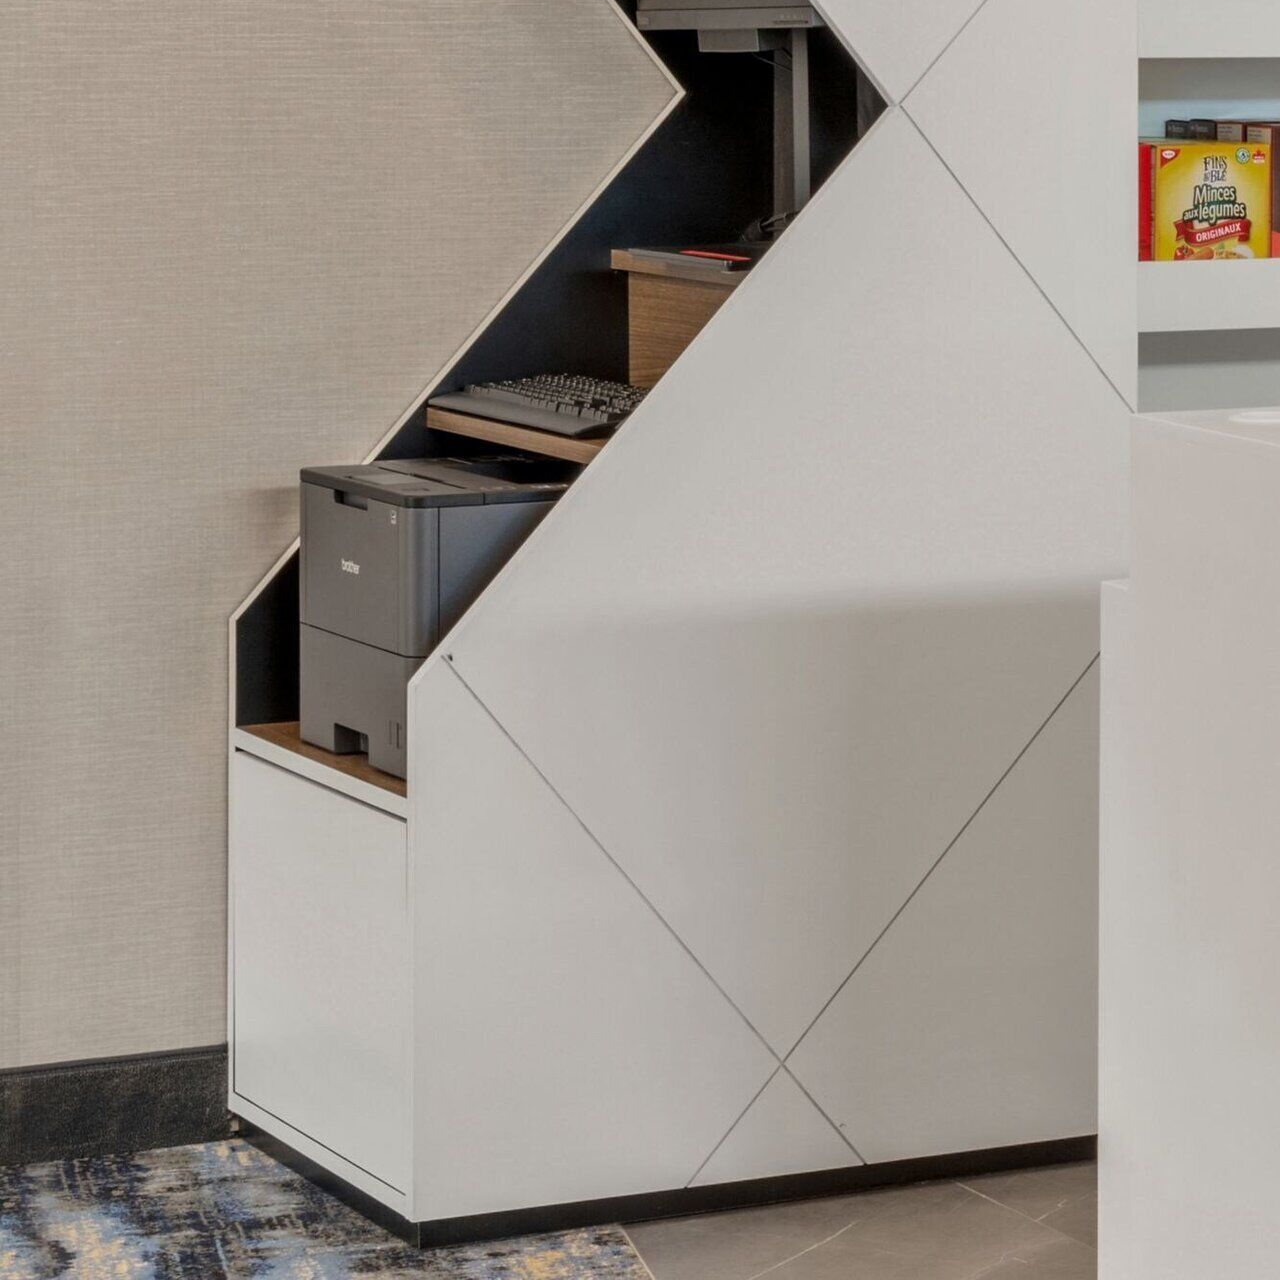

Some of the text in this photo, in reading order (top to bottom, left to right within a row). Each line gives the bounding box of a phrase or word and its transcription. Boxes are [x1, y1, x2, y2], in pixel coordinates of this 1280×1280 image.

[1195, 184, 1236, 203] Minces
[1183, 202, 1246, 224] aux légumes
[1195, 223, 1242, 242] ORIGINAUX
